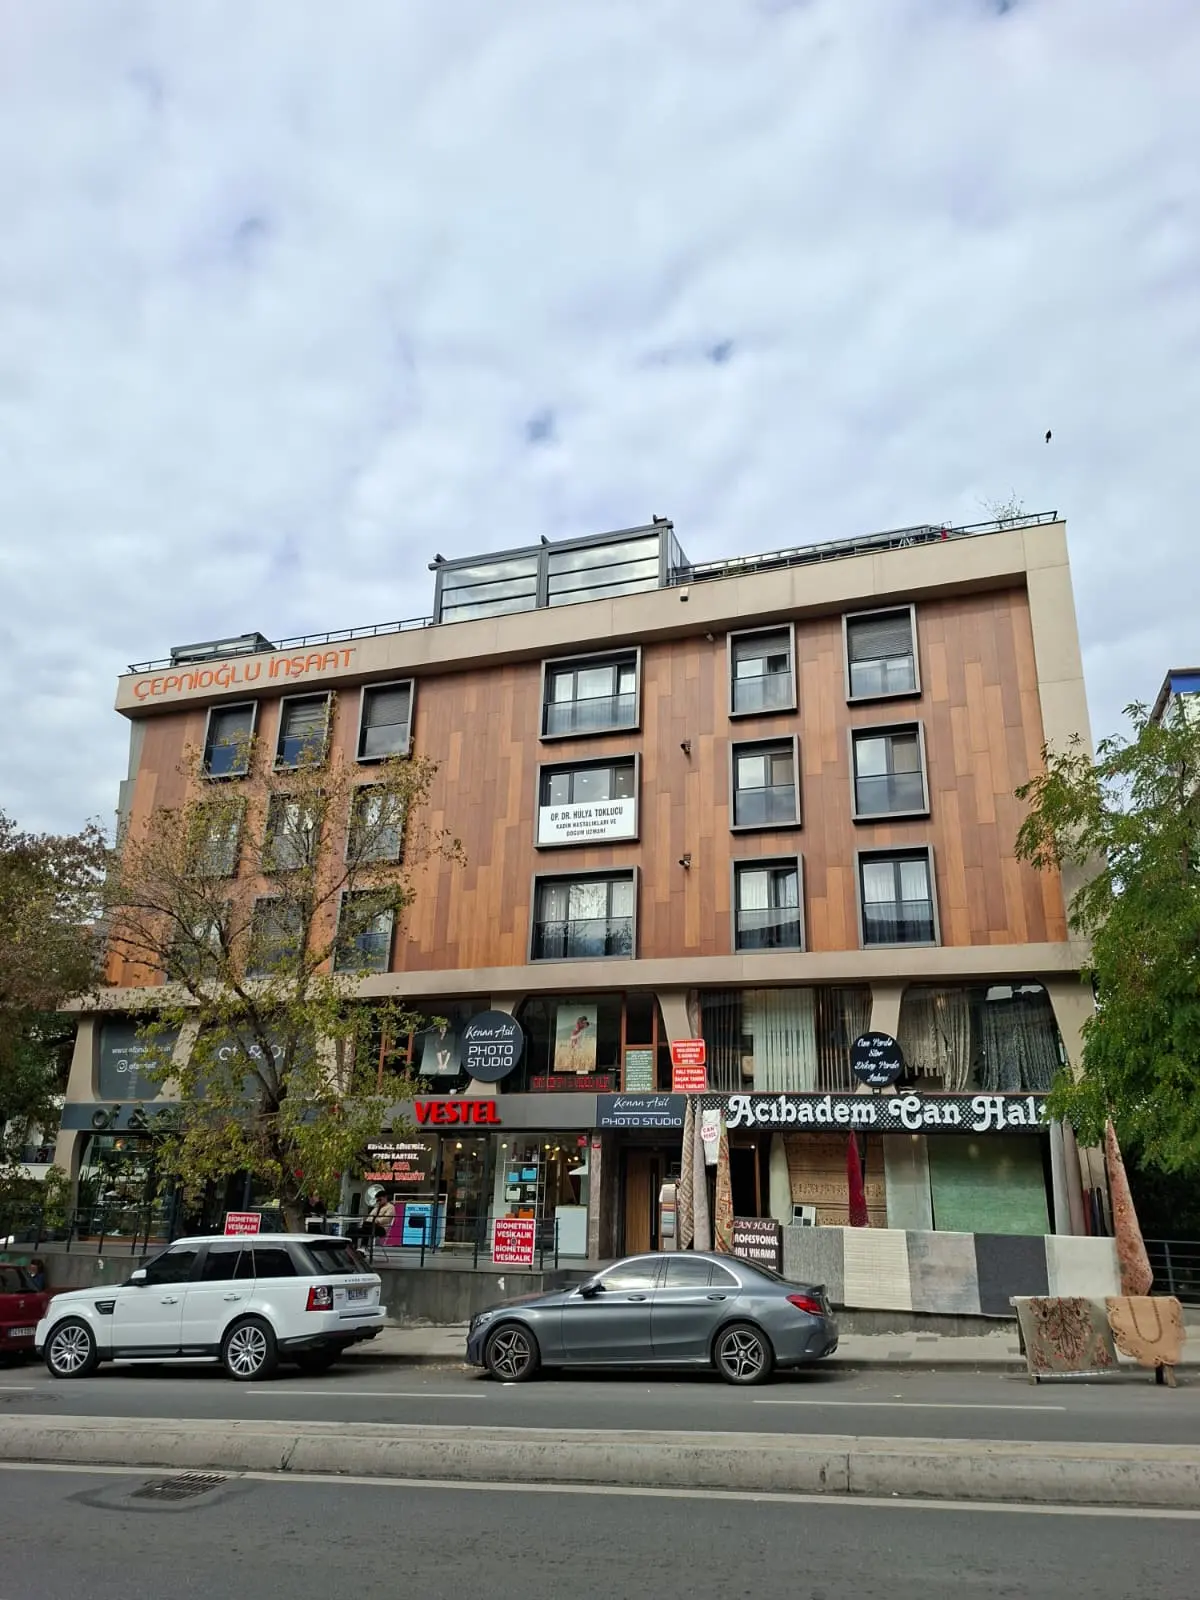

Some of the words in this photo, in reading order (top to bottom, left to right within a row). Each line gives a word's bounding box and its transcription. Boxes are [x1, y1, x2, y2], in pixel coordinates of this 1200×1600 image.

[573, 807, 592, 819] HÜLYA
[468, 1045, 514, 1056] PHOTO
[467, 1056, 513, 1067] STUDIO
[414, 1100, 501, 1124] VESTEL
[726, 1095, 877, 1129] Acıbadem
[888, 1096, 962, 1129] Can
[734, 1233, 779, 1246] ROFESYONEL
